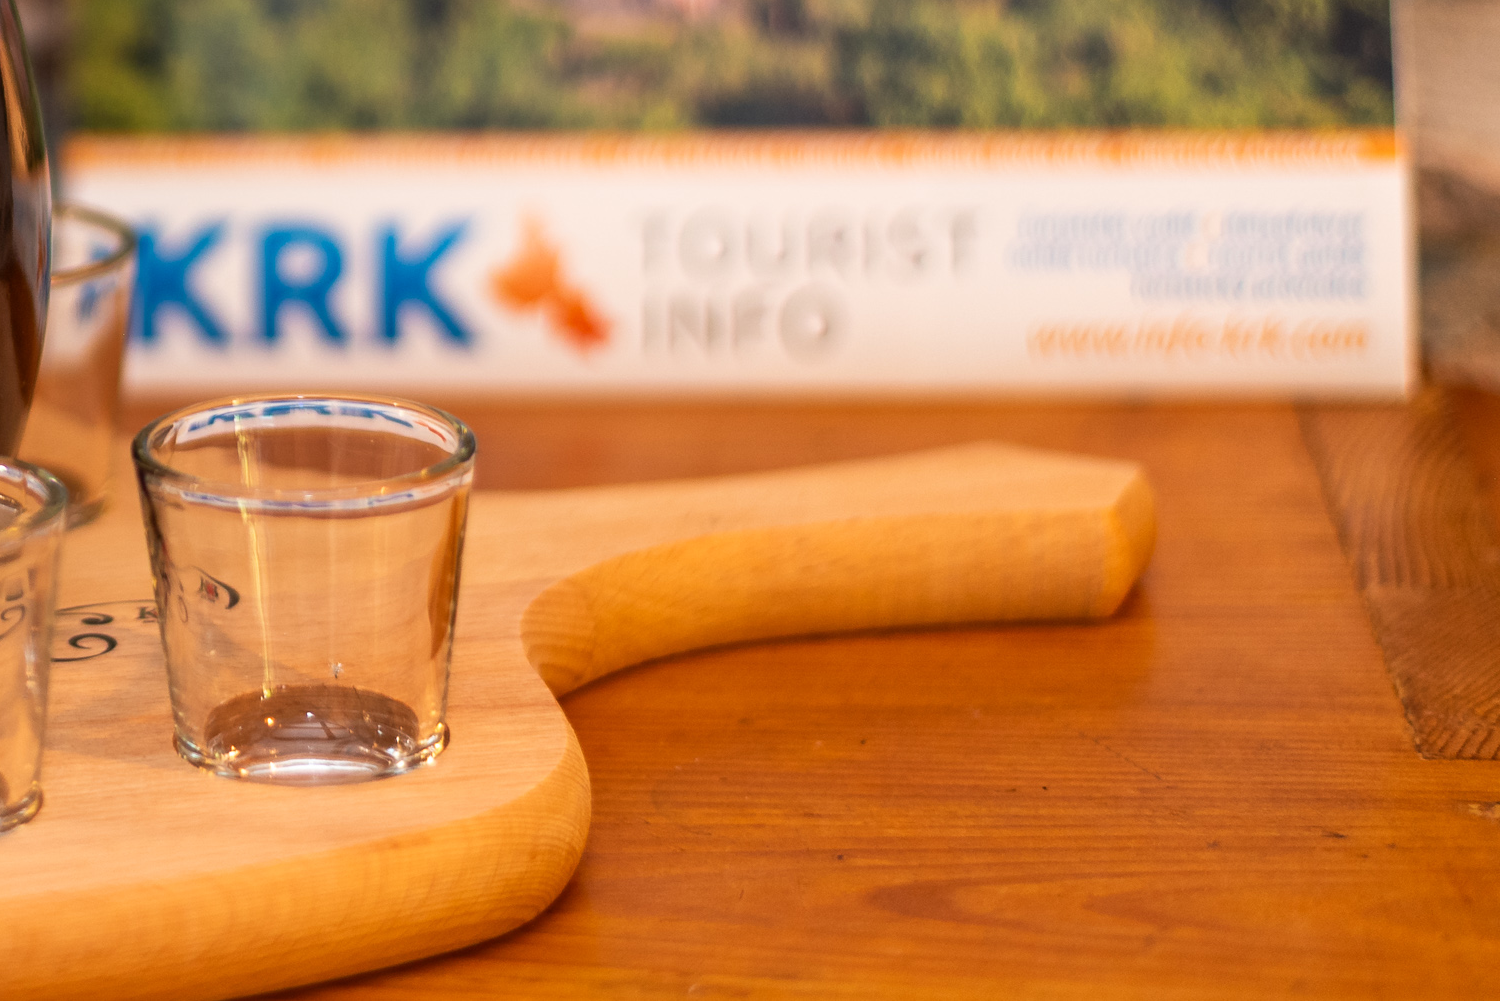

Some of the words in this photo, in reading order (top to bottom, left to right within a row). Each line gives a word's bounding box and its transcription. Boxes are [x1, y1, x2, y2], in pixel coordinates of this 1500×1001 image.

[132, 213, 476, 348] KRK
[632, 205, 982, 278] TOURIST
[640, 284, 848, 362] INFO
